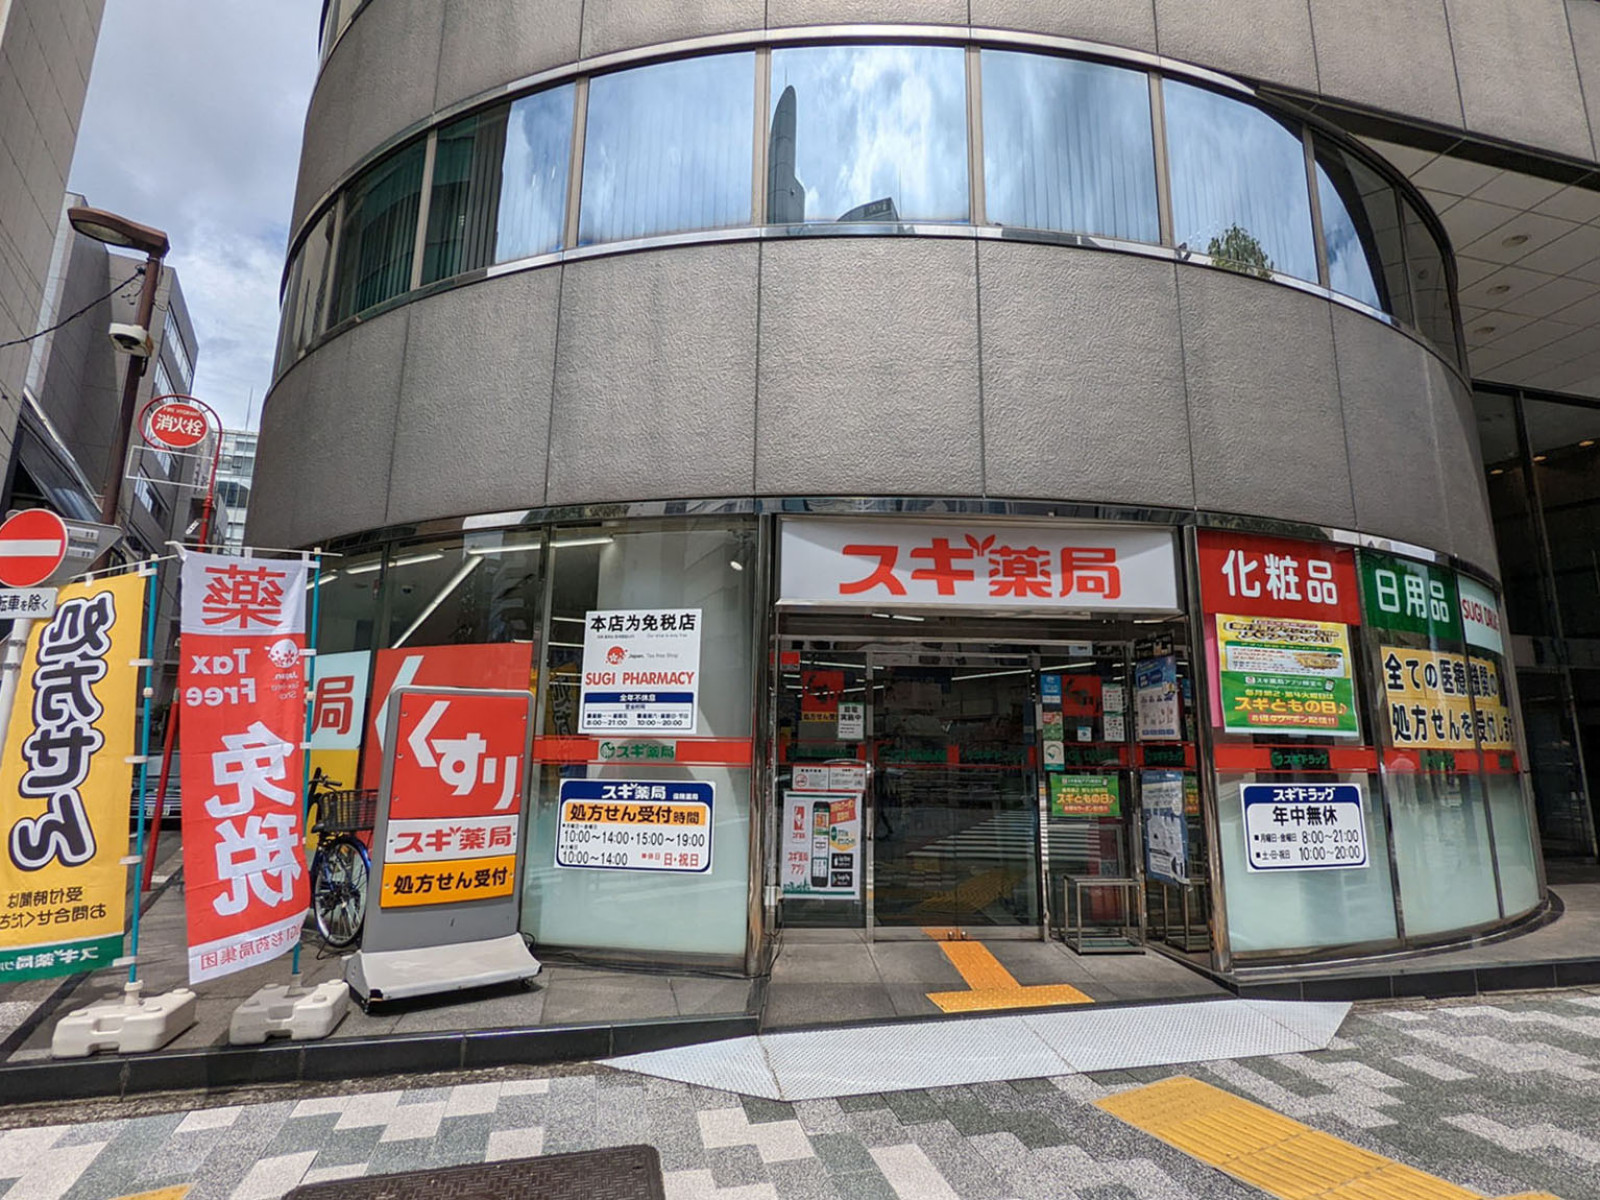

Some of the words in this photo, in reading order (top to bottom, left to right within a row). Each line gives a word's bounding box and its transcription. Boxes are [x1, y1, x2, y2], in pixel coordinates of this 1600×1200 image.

[155, 413, 204, 437] 消火栓
[838, 533, 1122, 599] スギ薬局
[1221, 549, 1338, 605] 化粧品
[1375, 568, 1450, 623] 日用品
[590, 613, 696, 633] 本店为免税店
[1462, 599, 1484, 625] SUGI
[585, 671, 616, 686] SUGI
[622, 671, 695, 686] PHARMACY
[407, 700, 519, 810] くすり
[616, 743, 675, 759] スギ薬局
[601, 782, 667, 800] スギ薬局
[1273, 787, 1336, 801] スギドラッグ
[1272, 805, 1338, 827] 年中無休
[393, 825, 512, 854] スギ薬局
[393, 867, 509, 895] 処方せん受付
